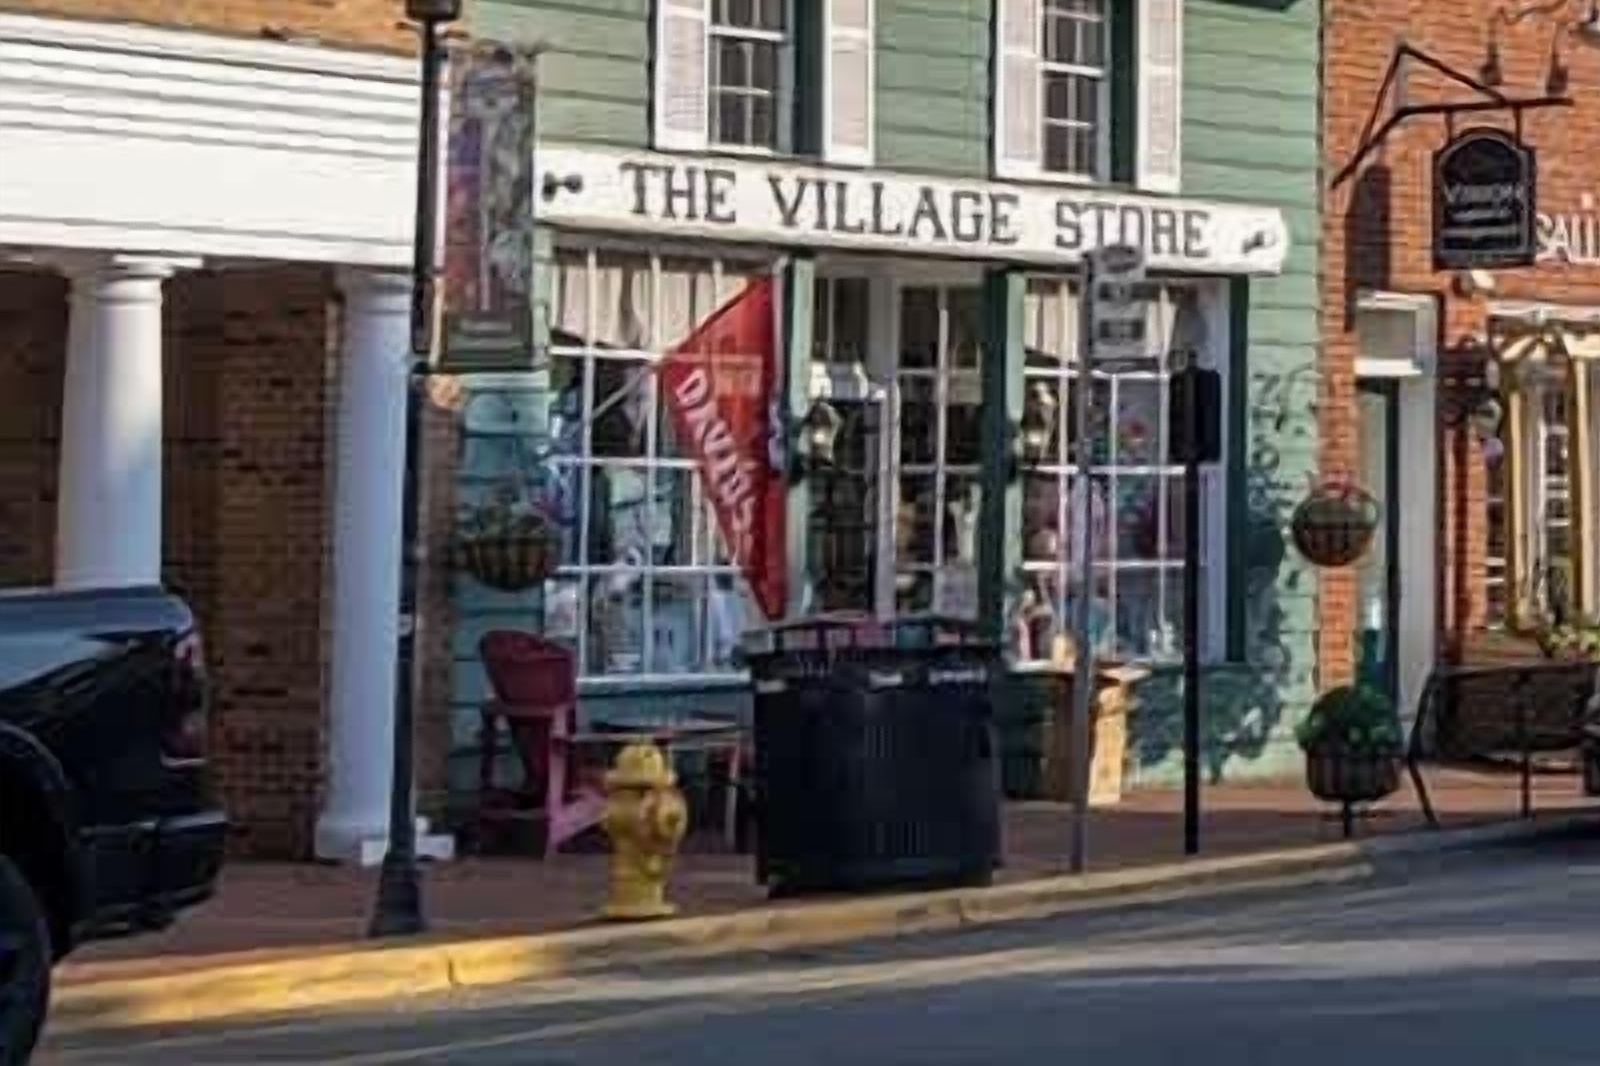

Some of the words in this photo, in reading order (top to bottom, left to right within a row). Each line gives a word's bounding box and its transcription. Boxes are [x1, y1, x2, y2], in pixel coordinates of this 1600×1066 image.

[619, 161, 737, 224] THE
[767, 174, 1020, 245] VILLAGE
[1055, 200, 1211, 259] STORE
